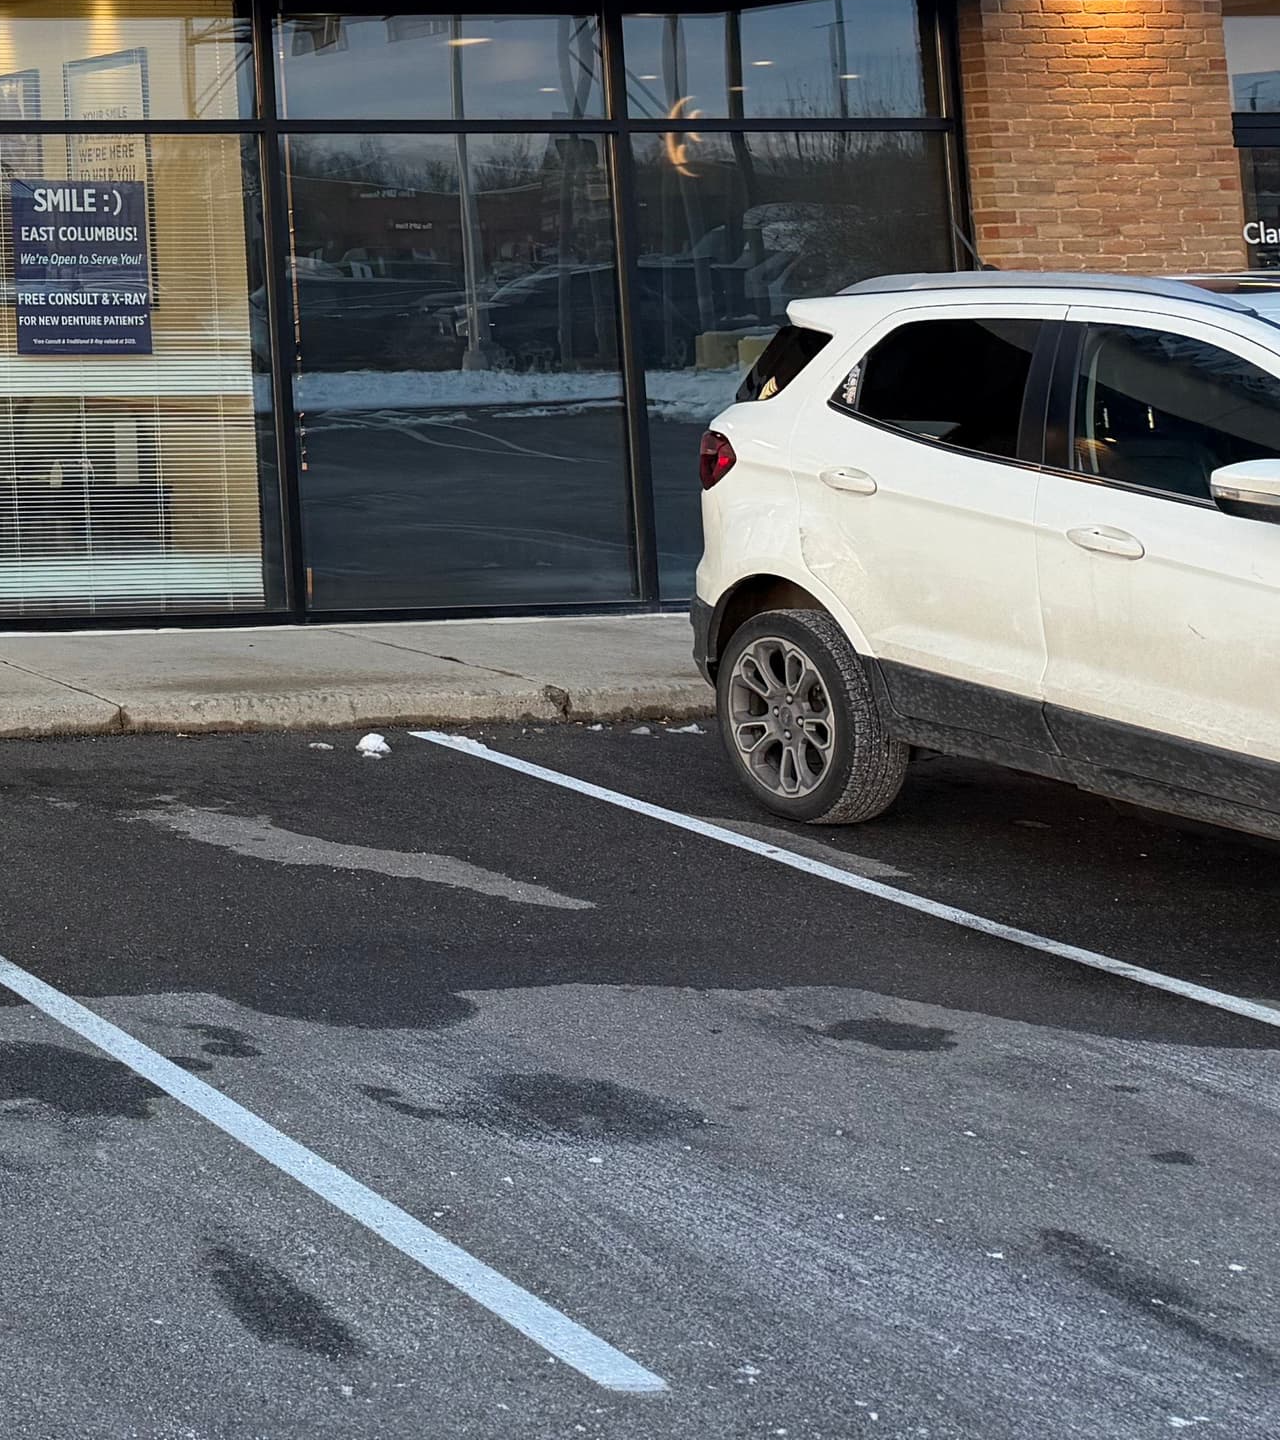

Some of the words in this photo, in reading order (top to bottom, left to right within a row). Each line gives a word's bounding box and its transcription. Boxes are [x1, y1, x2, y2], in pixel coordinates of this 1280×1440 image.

[109, 144, 135, 160] HERE
[33, 189, 97, 213] SMILE
[21, 226, 55, 241] EAST
[58, 226, 138, 242] COLUMBUS!
[1243, 221, 1280, 244] Cla
[20, 253, 49, 265] We're
[51, 253, 76, 267] Open
[79, 254, 89, 265] to
[91, 253, 118, 265] Serve
[120, 253, 142, 265] You!
[18, 293, 46, 305] FREE
[48, 293, 99, 306] CONSULT
[101, 293, 110, 305] &
[112, 292, 147, 306] X-RAY
[18, 316, 37, 326] FOR
[38, 315, 59, 326] NEW
[61, 316, 102, 326] DENTURE
